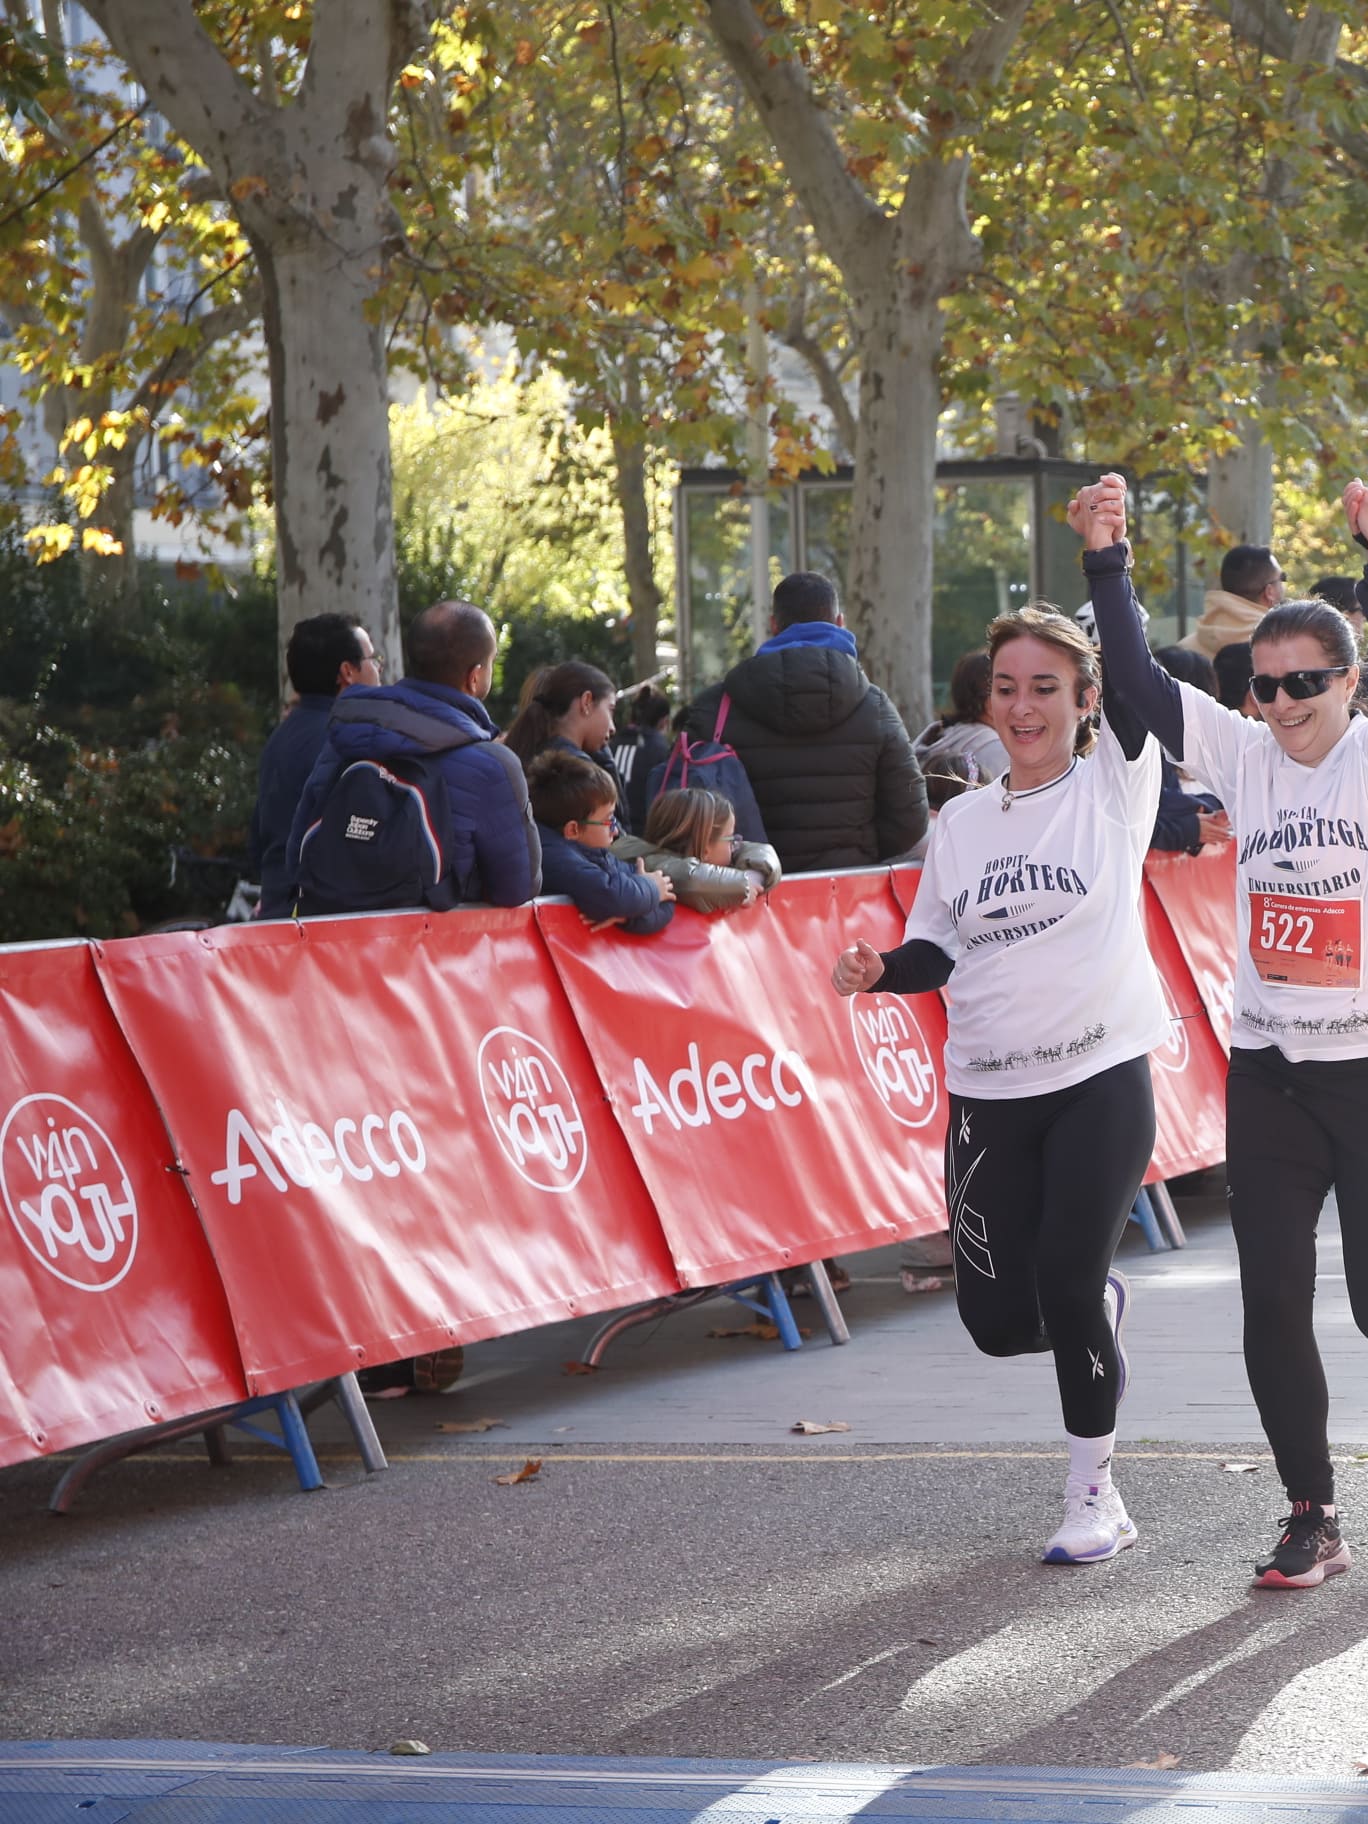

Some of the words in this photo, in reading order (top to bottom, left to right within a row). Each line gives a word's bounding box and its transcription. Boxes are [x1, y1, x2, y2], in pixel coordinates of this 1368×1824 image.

[984, 854, 1029, 874] HOSPIT
[1248, 867, 1361, 897] UNIVERSITARIO
[975, 863, 1089, 906] HORTEGA
[1271, 901, 1288, 910] Carrera
[1295, 906, 1321, 914] empresas
[1322, 907, 1345, 915] Adecco
[1260, 910, 1314, 954] 522
[210, 1098, 427, 1205] Adecco
